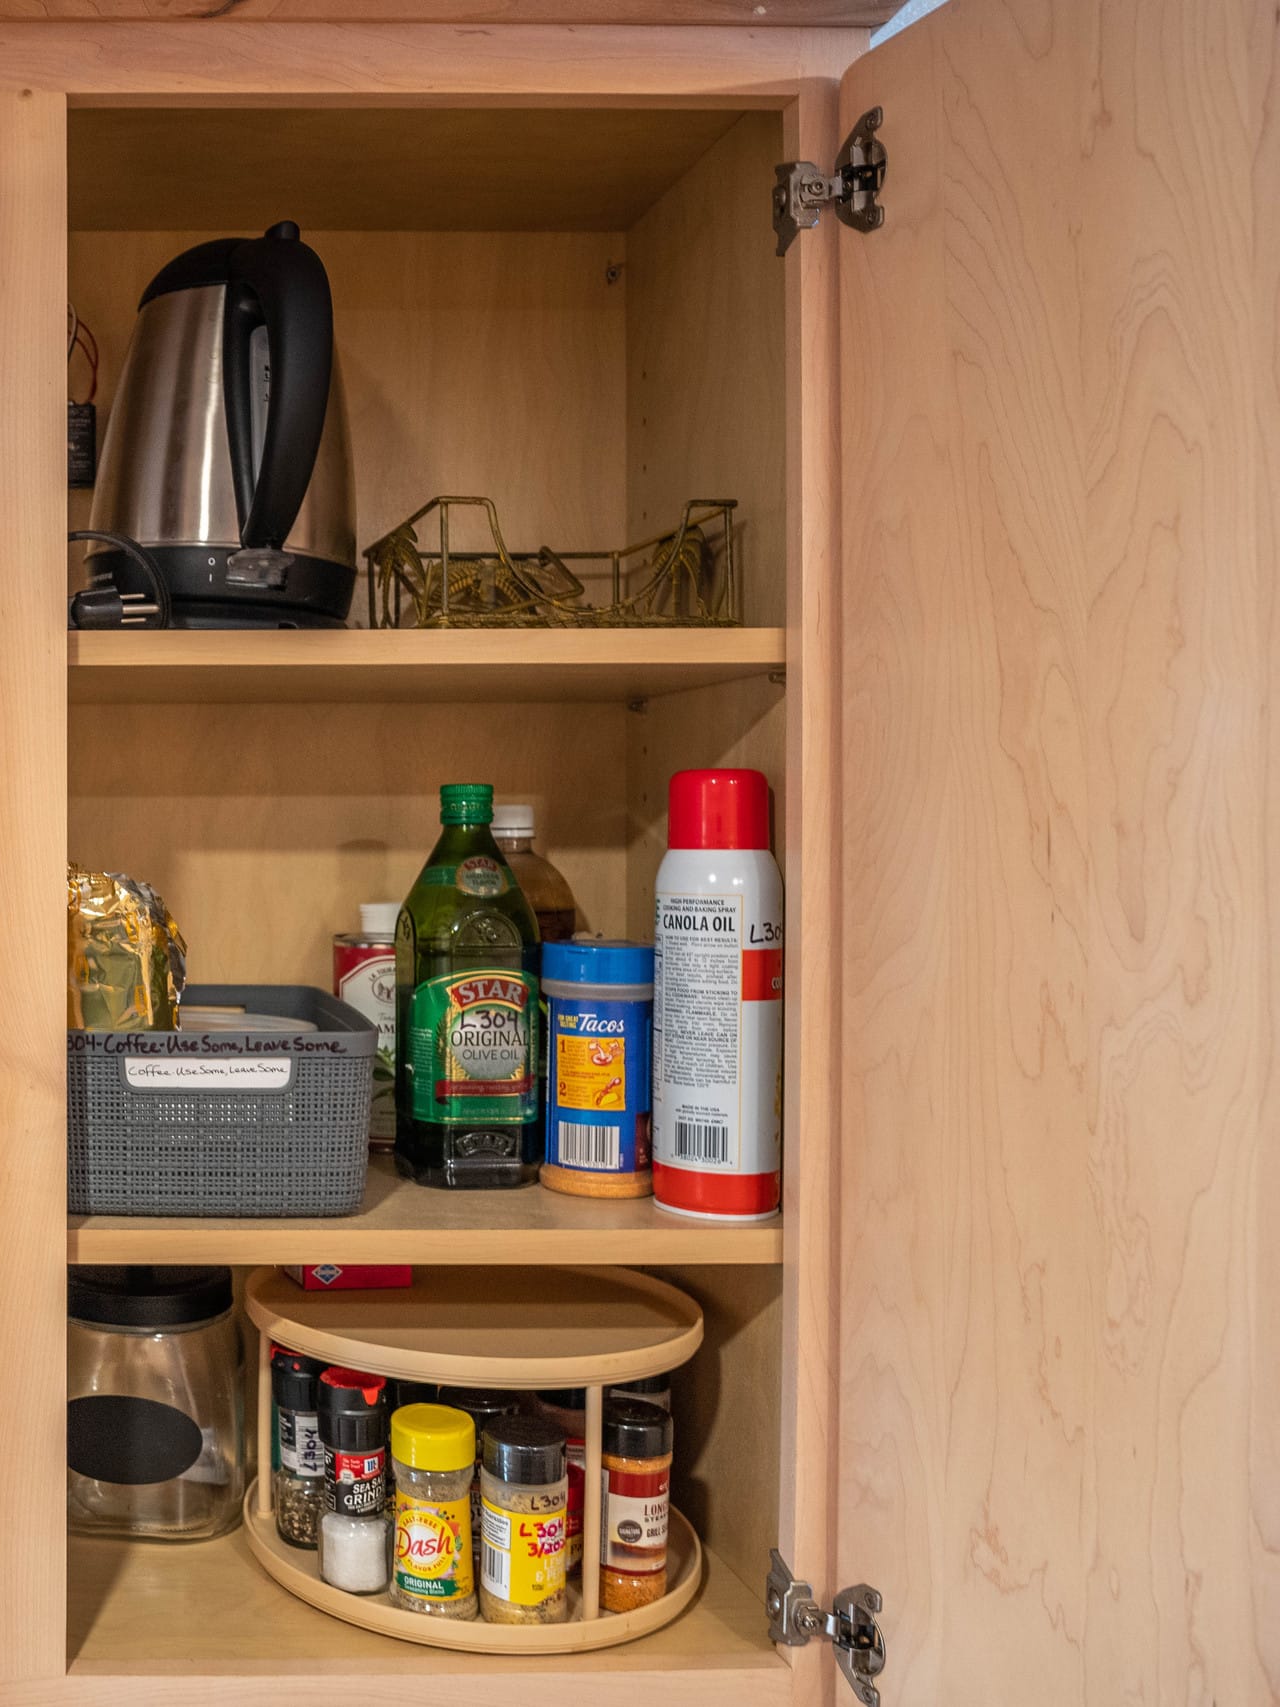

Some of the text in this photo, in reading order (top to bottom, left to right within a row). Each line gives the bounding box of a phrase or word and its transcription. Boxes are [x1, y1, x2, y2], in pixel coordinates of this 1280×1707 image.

[683, 898, 724, 906] PERFORMANCE
[663, 913, 735, 932] CANOLA OIL
[750, 921, 782, 943] L30
[458, 979, 523, 1004] STAR
[460, 1009, 518, 1033] L304
[578, 1013, 624, 1033] Tacos
[245, 1035, 291, 1052] Leave
[293, 1036, 347, 1054] Some
[451, 1030, 529, 1047] ORIGINAL
[560, 1039, 566, 1053] 1
[462, 1049, 520, 1061] OLIVE OIL
[229, 1065, 257, 1074] Leave
[258, 1063, 287, 1074] Some
[559, 1081, 567, 1096] 2
[343, 1485, 383, 1506] GRIND
[352, 1482, 371, 1494] SEA
[396, 1526, 452, 1558] Dash
[407, 1559, 432, 1572] FLAVOR
[403, 1575, 443, 1590] ORIGINAL
[404, 1584, 428, 1596] Seasoning
